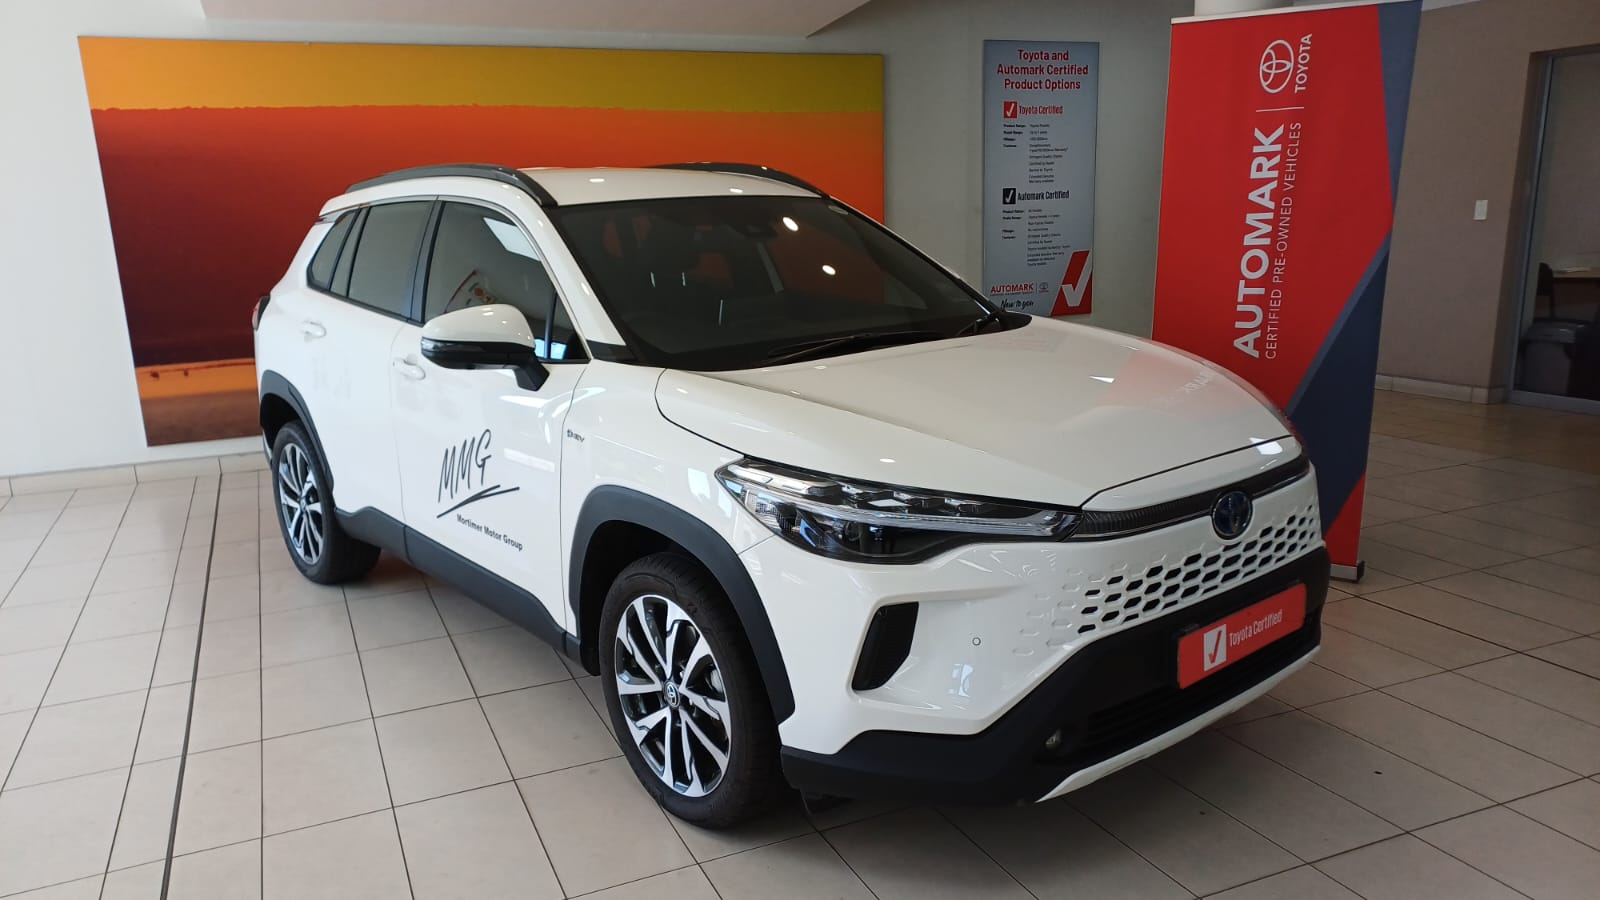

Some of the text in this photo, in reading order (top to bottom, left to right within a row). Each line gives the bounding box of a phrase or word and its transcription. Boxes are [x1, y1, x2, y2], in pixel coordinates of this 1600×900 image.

[1017, 49, 1069, 62] Toyota and
[1294, 33, 1312, 93] TOYOTA
[997, 64, 1088, 75] Automark Certified
[1004, 79, 1081, 91] Product Options
[1019, 105, 1063, 116] Toyota Certified
[1017, 190, 1070, 201] Automark Certified
[1233, 124, 1285, 358] AUTOMARK
[1265, 121, 1302, 359] CERTIFIED PRE-OWNED VEHICLES
[990, 283, 1034, 293] AUTOMARK
[437, 429, 492, 503] MMG
[457, 513, 523, 552] Mortimer Motor Group
[1229, 609, 1283, 647] Toyota Certified
